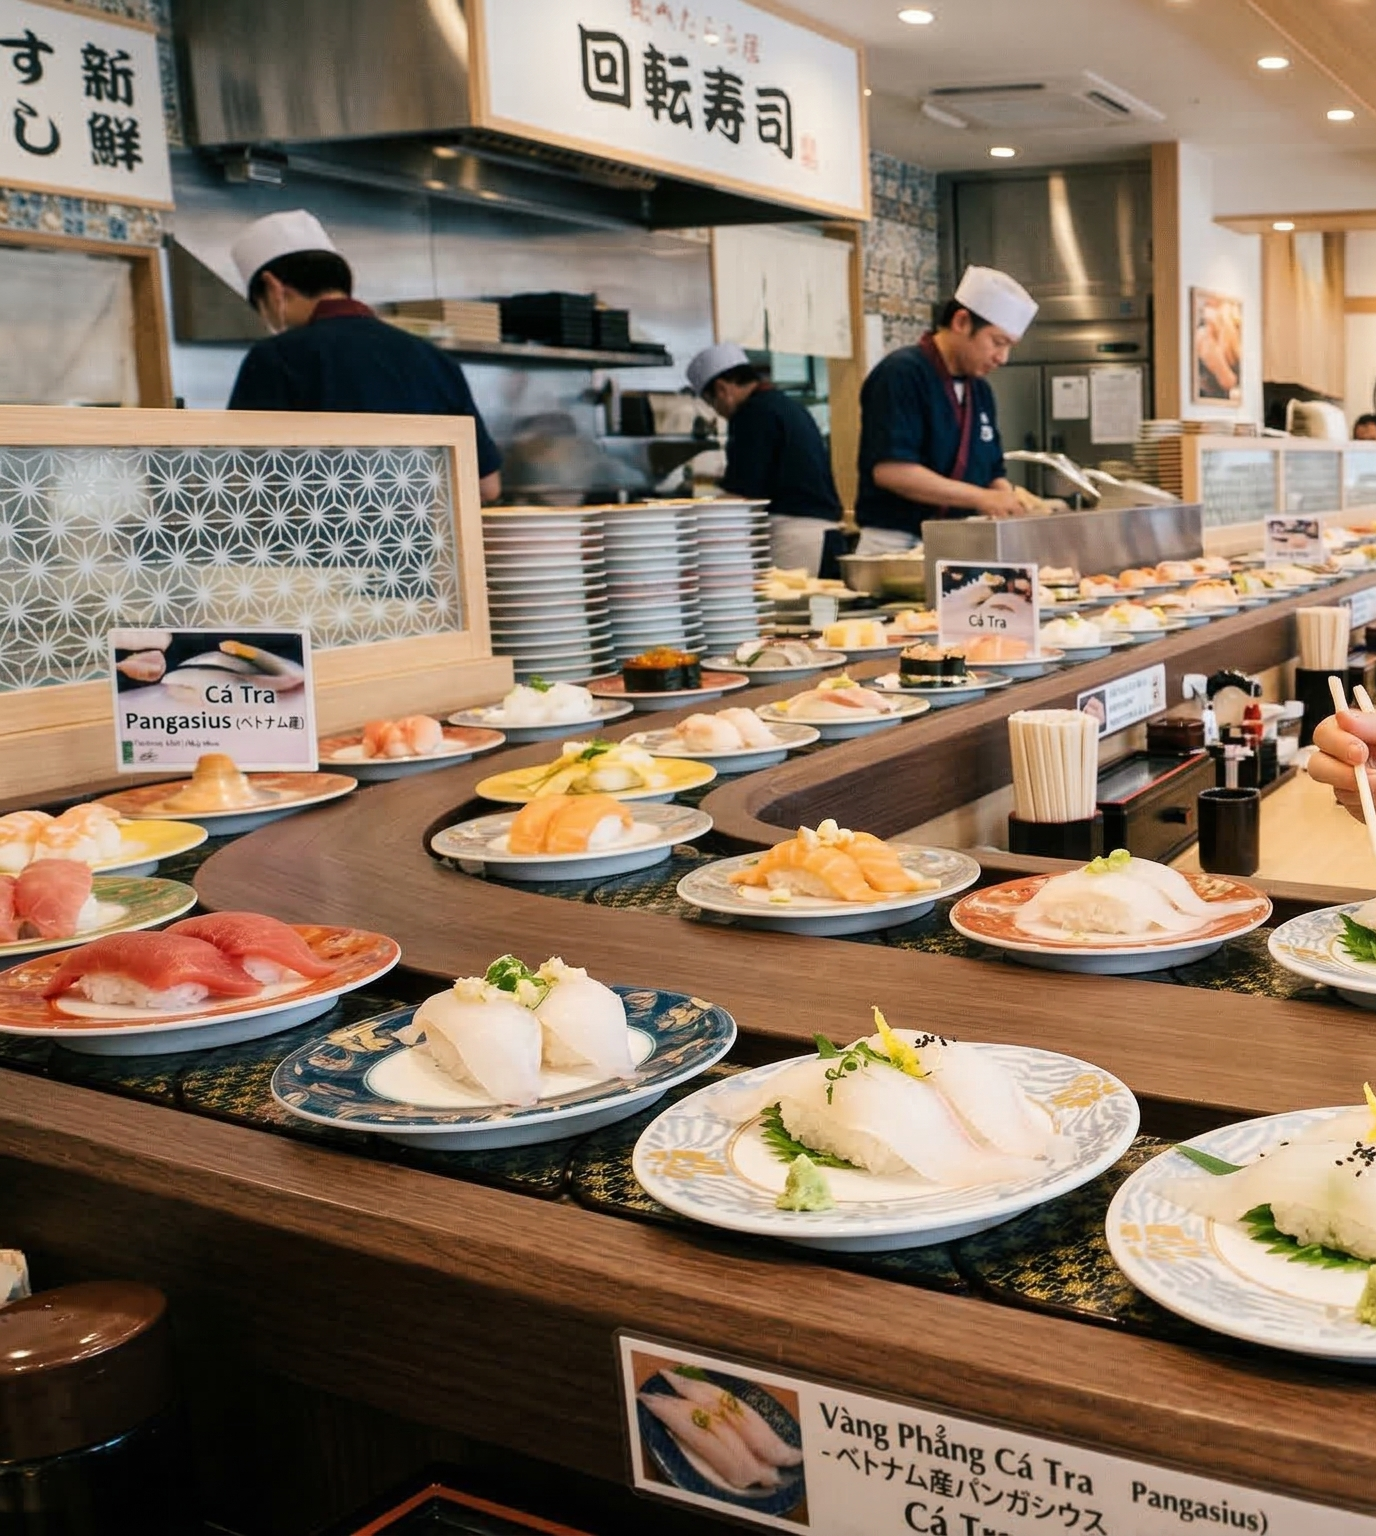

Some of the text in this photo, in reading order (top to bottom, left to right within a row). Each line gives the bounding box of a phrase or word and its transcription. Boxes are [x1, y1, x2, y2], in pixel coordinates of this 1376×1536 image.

[0, 28, 62, 157] すし
[80, 42, 144, 172] 新鮮
[577, 22, 795, 160] 回転寿司
[987, 615, 1007, 629] Tra
[125, 711, 232, 735] Pangasius
[204, 684, 276, 704] Cá Tra
[819, 1402, 1269, 1535] Vàng Phẳng Cá Tra Pangasius)
